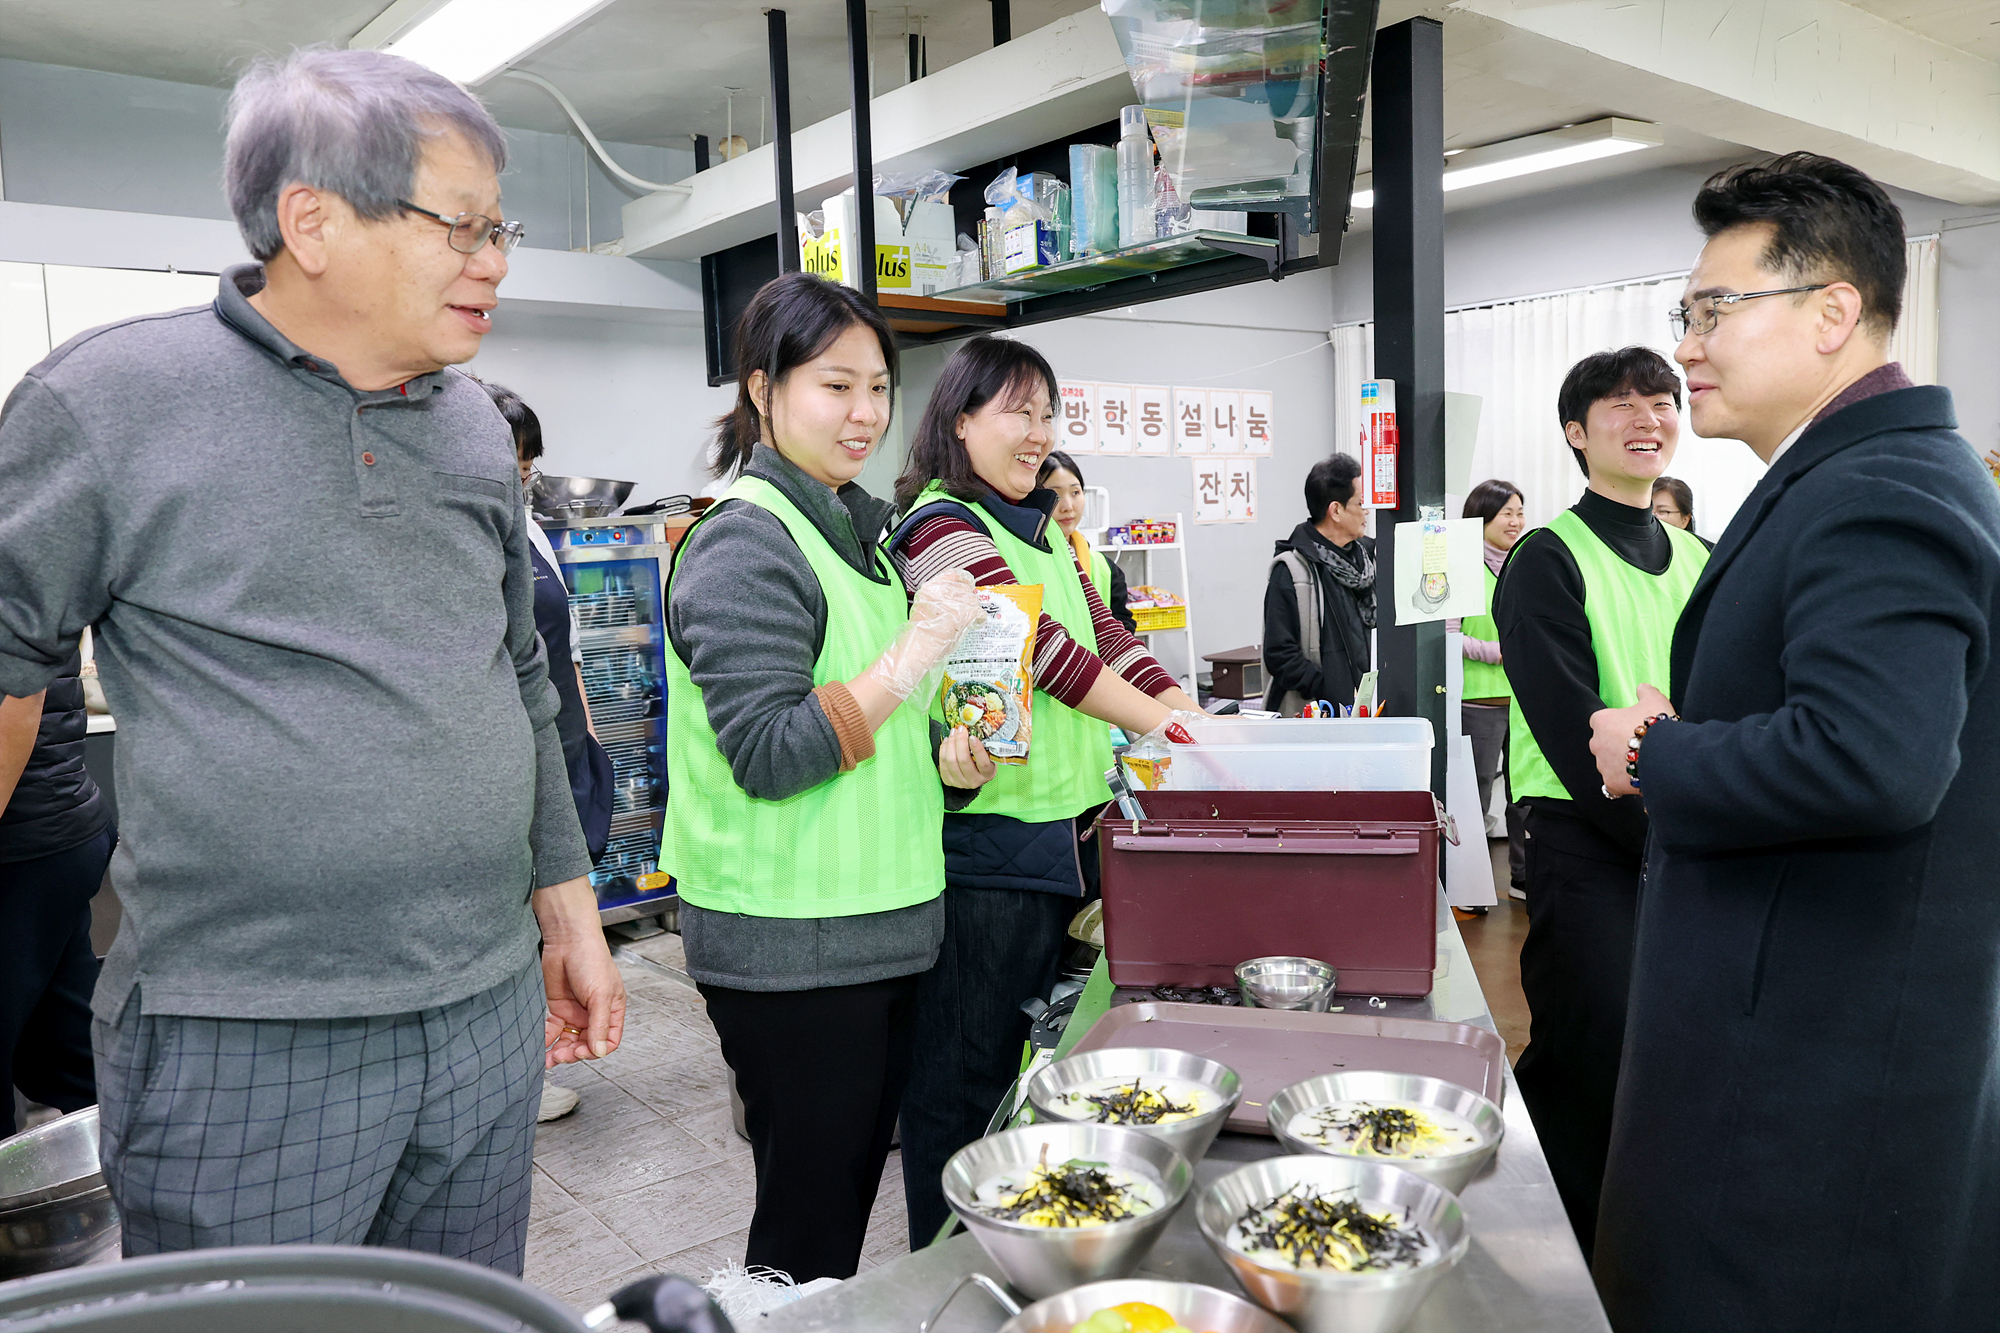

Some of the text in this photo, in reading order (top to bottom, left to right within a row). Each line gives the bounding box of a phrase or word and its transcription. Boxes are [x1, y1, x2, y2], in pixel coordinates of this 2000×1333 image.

[877, 253, 907, 278] lus
[1065, 400, 1268, 439] 방학동 설나눔
[1199, 471, 1250, 504] 잔치
